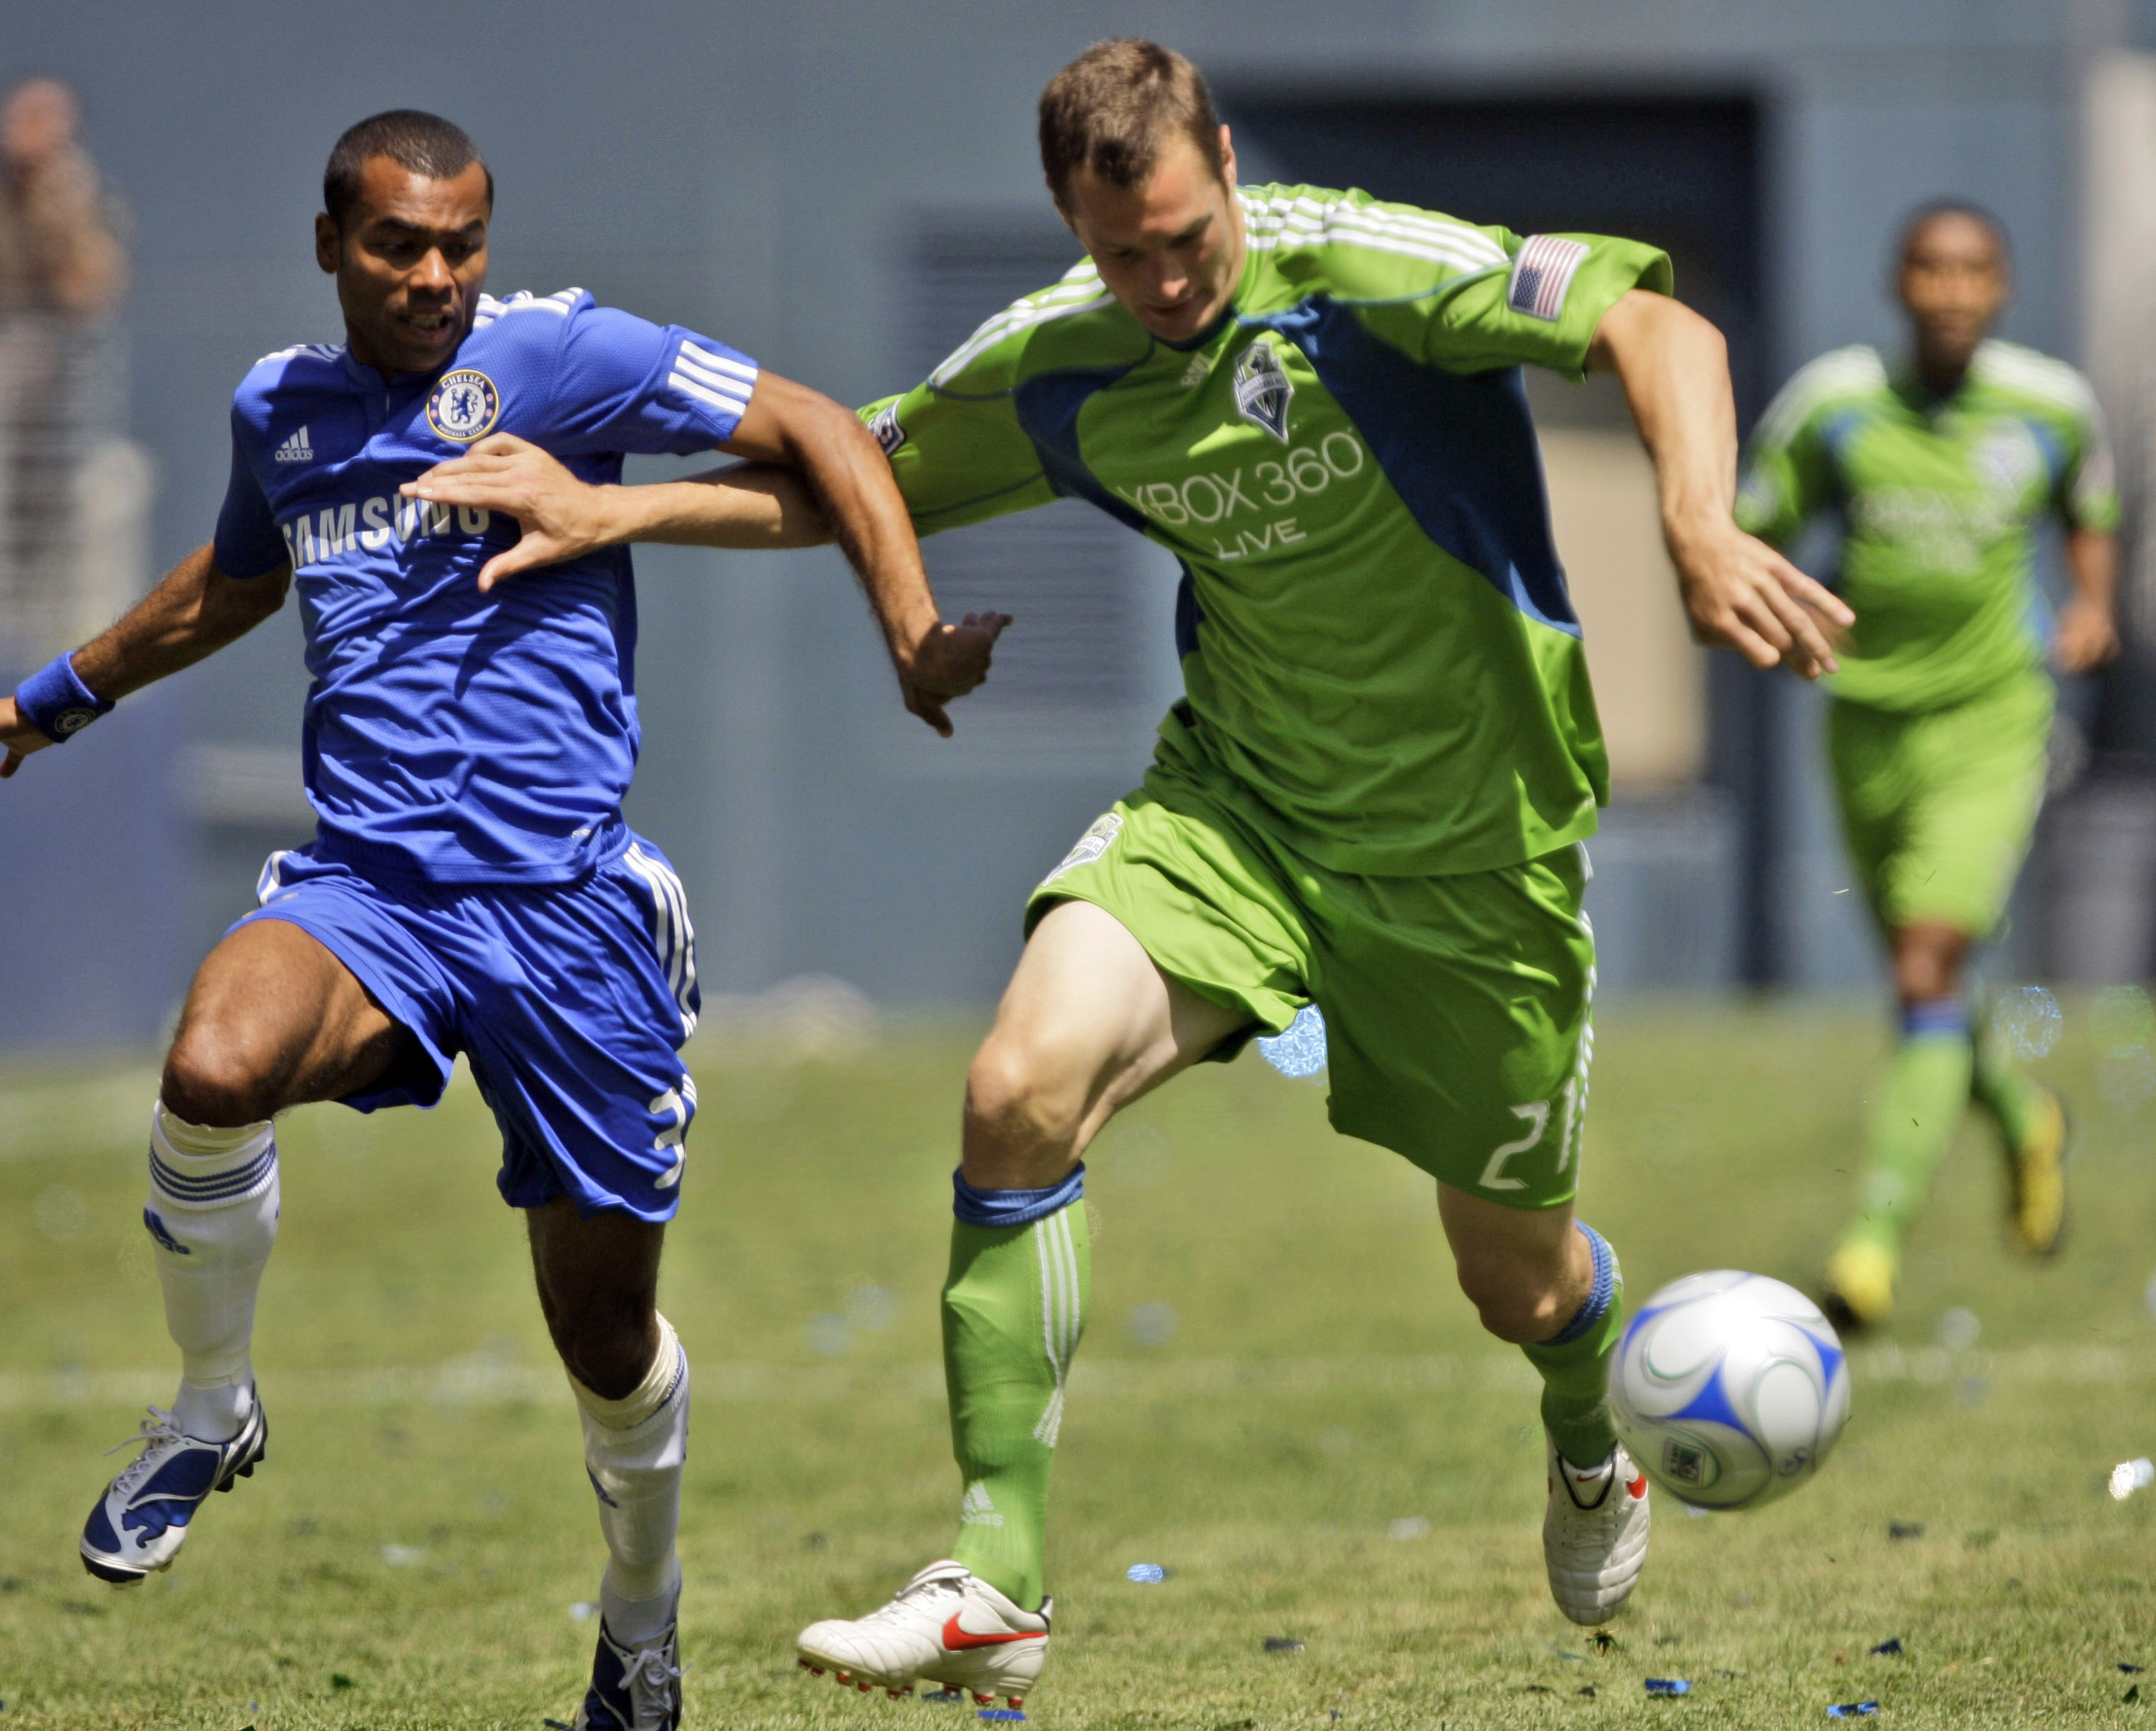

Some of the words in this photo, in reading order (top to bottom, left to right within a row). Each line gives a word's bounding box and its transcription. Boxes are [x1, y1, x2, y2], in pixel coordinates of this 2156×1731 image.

[442, 374, 484, 390] CHELSEA
[437, 424, 467, 437] FOOTBALL
[469, 423, 484, 435] CLUB
[275, 447, 313, 462] adidas
[1116, 467, 1259, 525] XBOX
[1255, 431, 1364, 506] 360
[1213, 517, 1307, 560] LIVE
[648, 1086, 688, 1189] 3
[1478, 1076, 1578, 1191] 21
